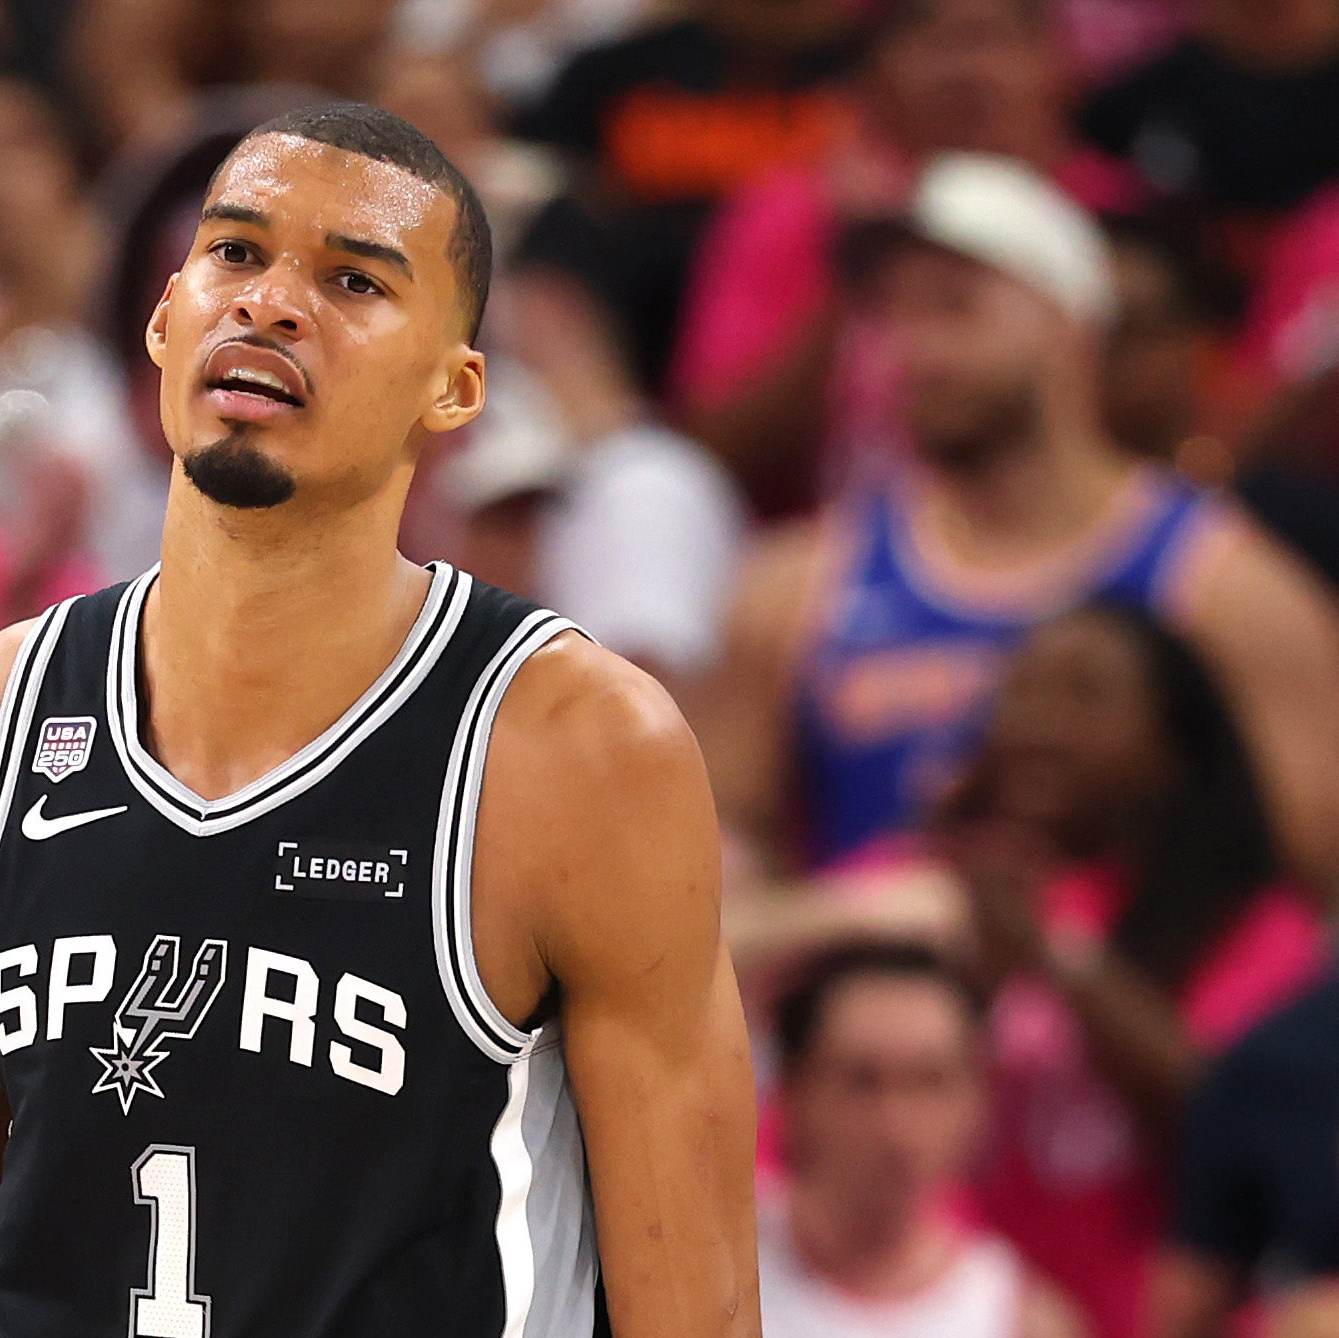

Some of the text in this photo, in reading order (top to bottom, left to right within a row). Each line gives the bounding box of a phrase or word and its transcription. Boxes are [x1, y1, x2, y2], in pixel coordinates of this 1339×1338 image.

[46, 726, 87, 741] USA
[37, 749, 85, 767] 250
[293, 856, 390, 883] LEDGER
